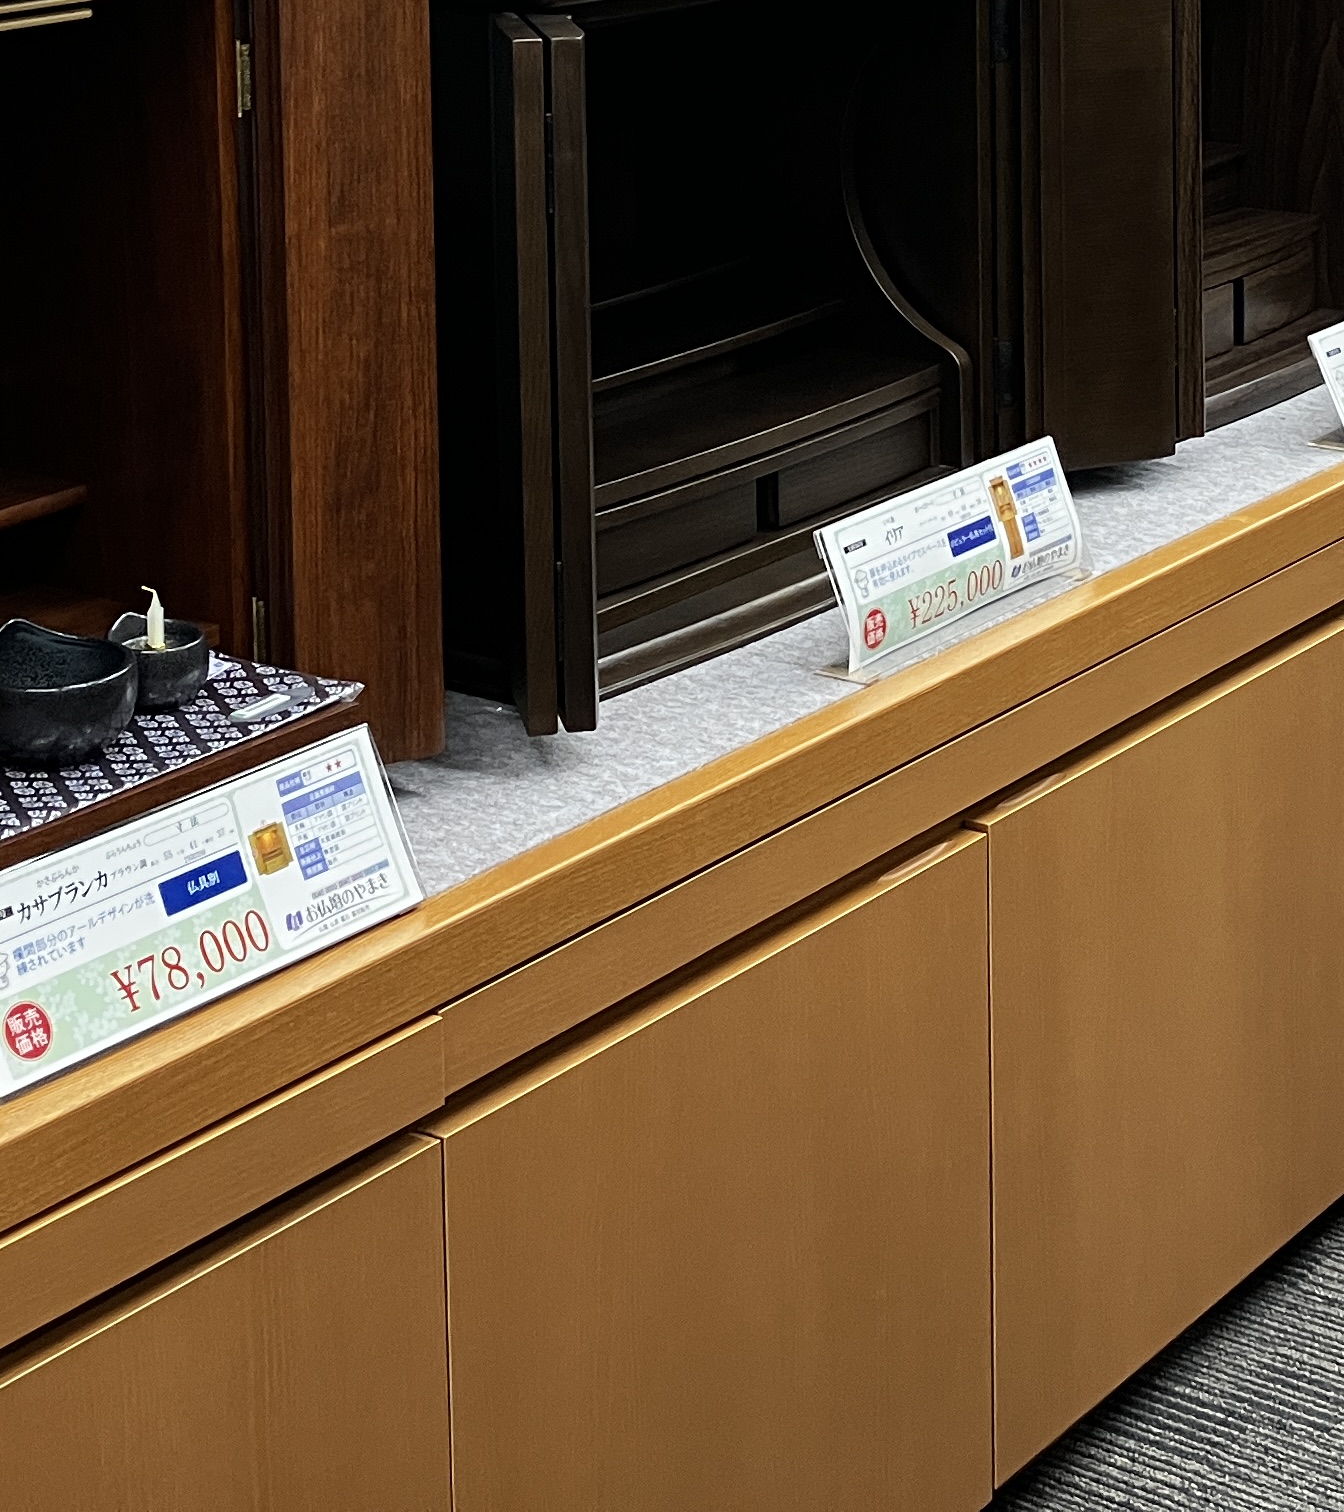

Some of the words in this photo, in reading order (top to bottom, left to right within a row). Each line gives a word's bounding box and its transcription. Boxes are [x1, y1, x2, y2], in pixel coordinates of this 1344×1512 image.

[907, 559, 1003, 630] ¥225,000
[16, 869, 110, 925] カサブランカ
[186, 869, 222, 897] 仏具別
[110, 909, 270, 1014] ¥78,000
[6, 1006, 44, 1038] 販売
[14, 1026, 50, 1057] 価格
